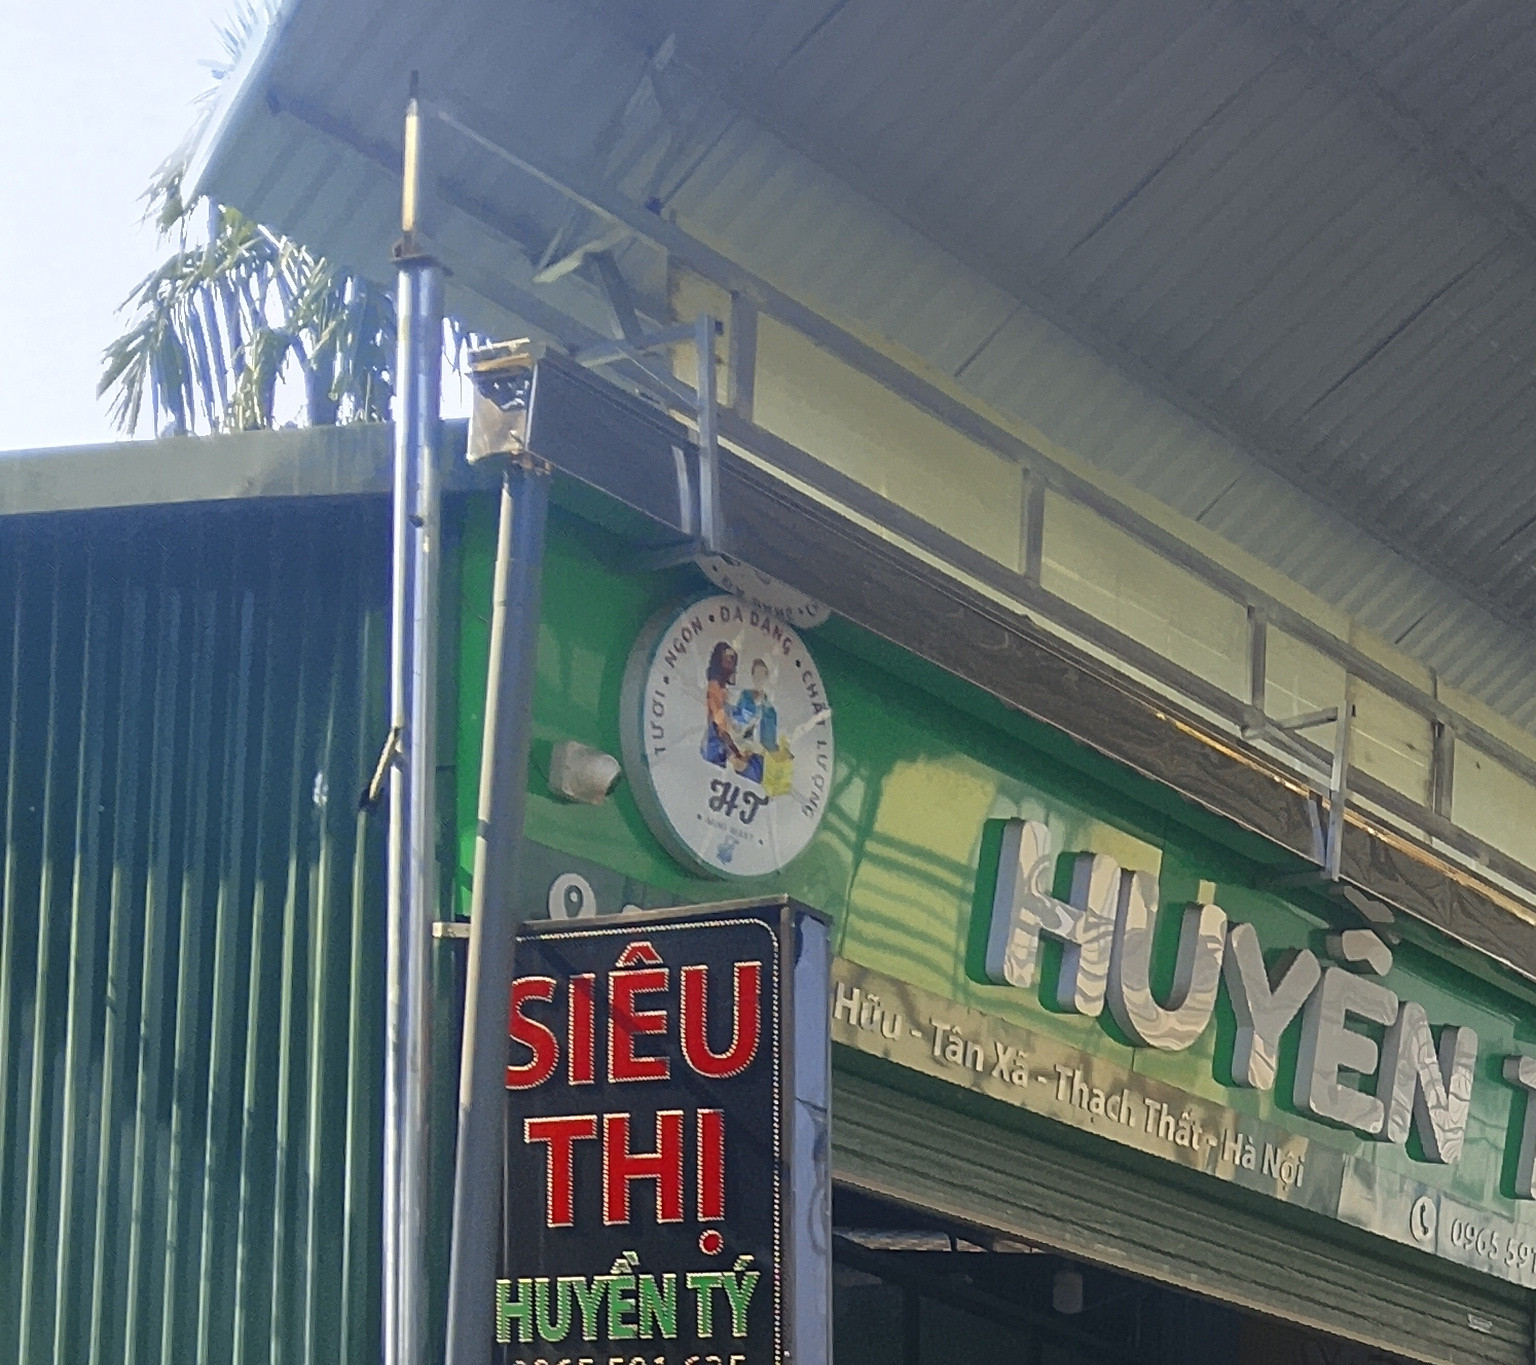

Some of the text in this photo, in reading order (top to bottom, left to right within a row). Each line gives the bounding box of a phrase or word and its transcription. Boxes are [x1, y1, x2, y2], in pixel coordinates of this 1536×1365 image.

[665, 616, 706, 669] NGON
[505, 941, 763, 1090] SIÊU
[833, 981, 900, 1040] Hữu
[931, 1018, 984, 1074] Tân
[990, 1040, 1030, 1090] Xã
[1055, 1063, 1136, 1124] Thạch
[1222, 1128, 1257, 1171] Hà
[1262, 1142, 1305, 1193] Nội
[524, 1107, 725, 1256] THỊ
[1450, 1217, 1500, 1260] 0965
[496, 1251, 761, 1344] HUYỀN TÝ
